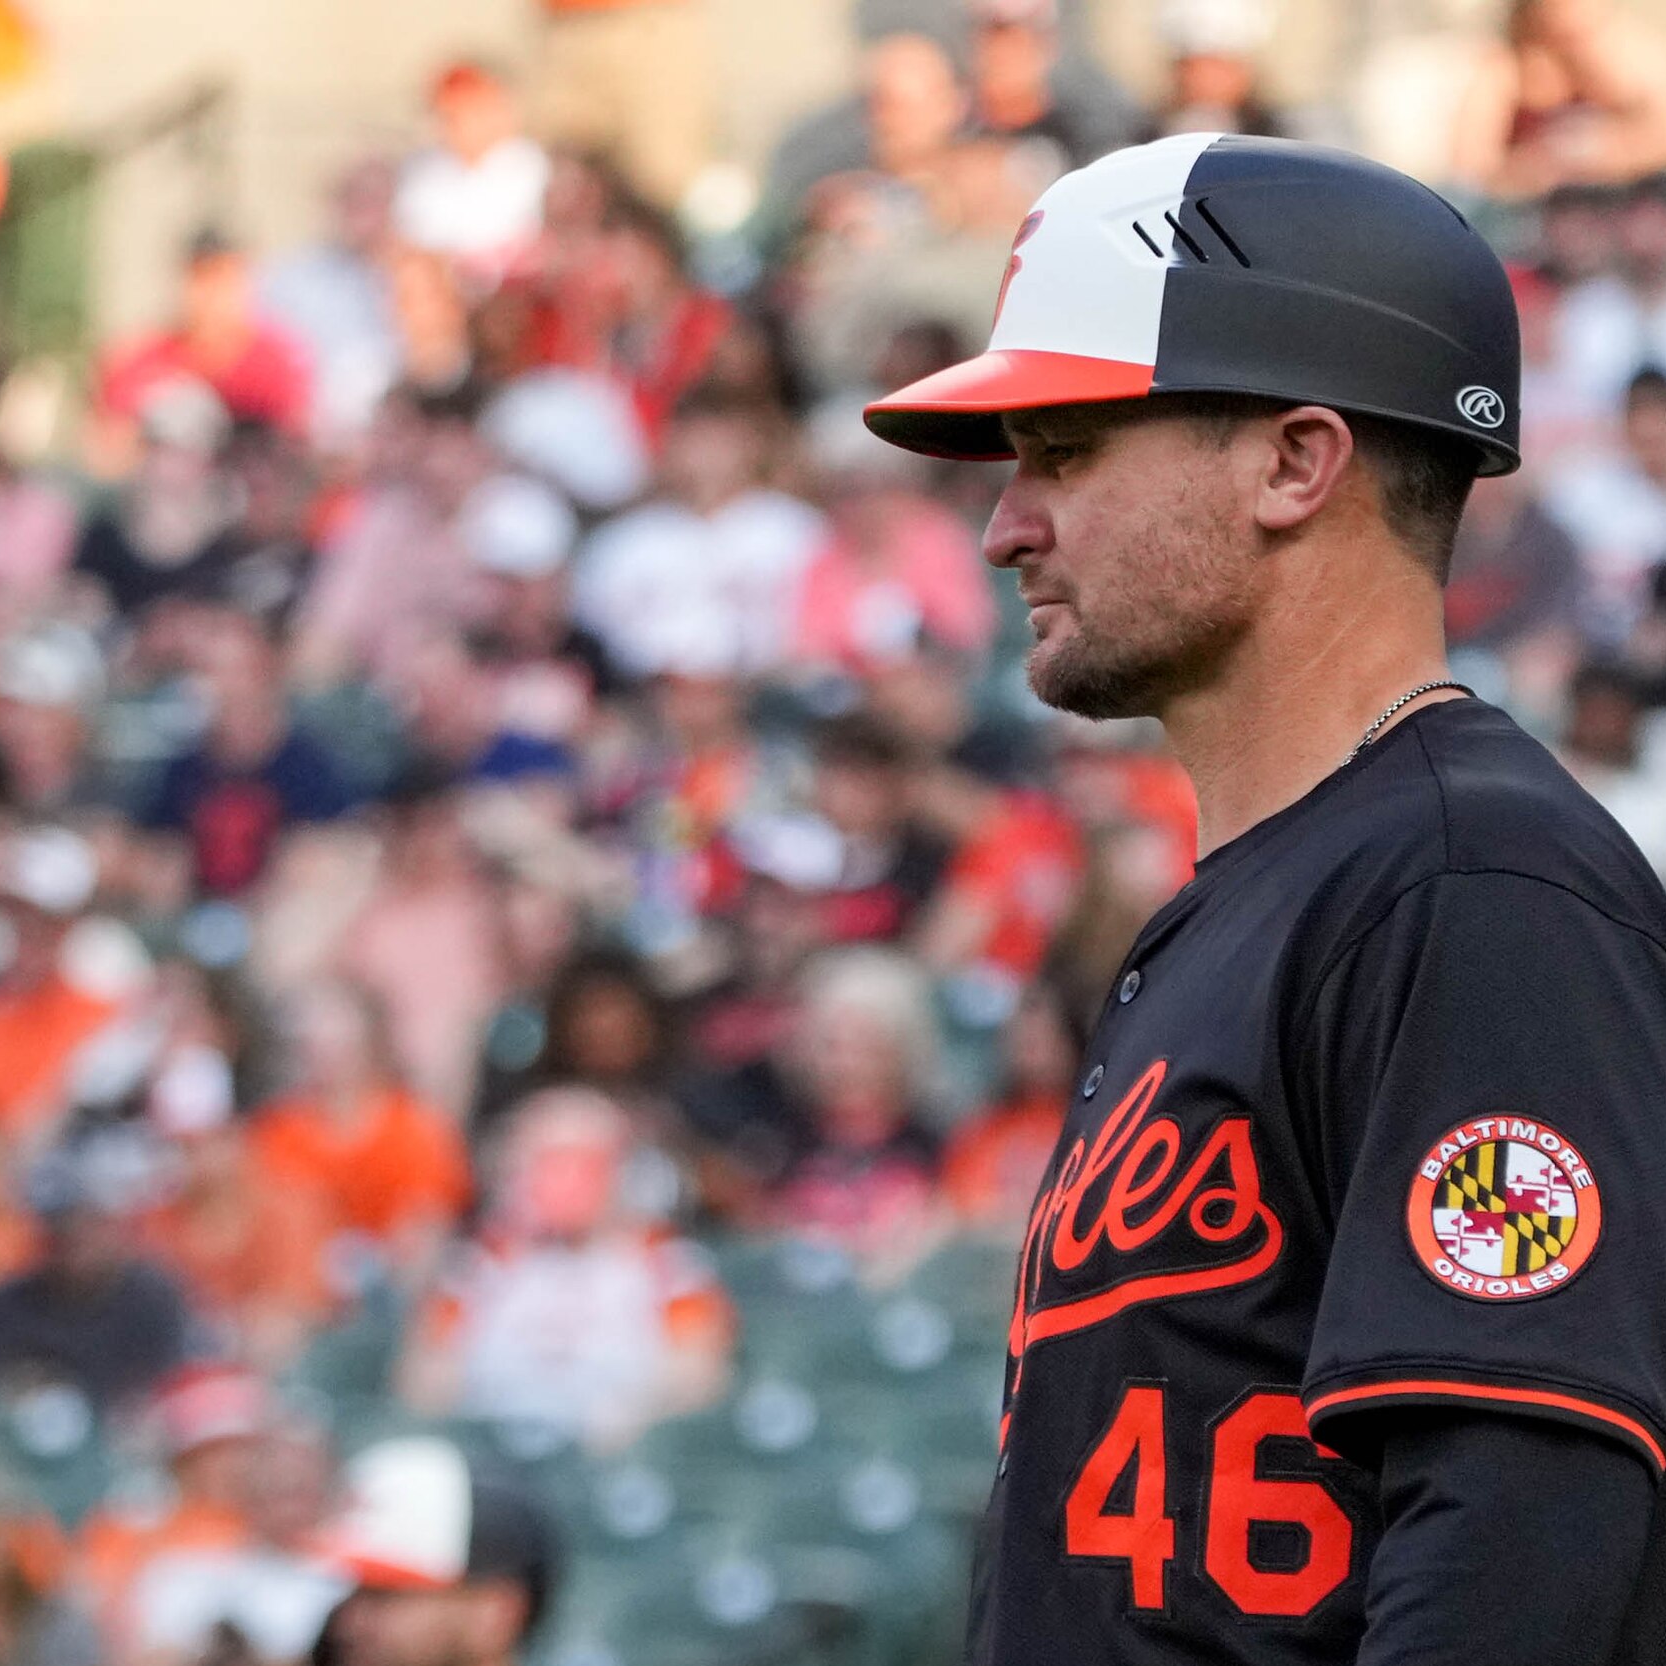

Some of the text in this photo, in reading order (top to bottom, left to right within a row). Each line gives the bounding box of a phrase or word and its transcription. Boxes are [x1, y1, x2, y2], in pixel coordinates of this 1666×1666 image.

[1419, 1119, 1594, 1191] BALTIMORE
[1433, 1257, 1571, 1297] ORIOLES
[1065, 1386, 1354, 1617] 46
